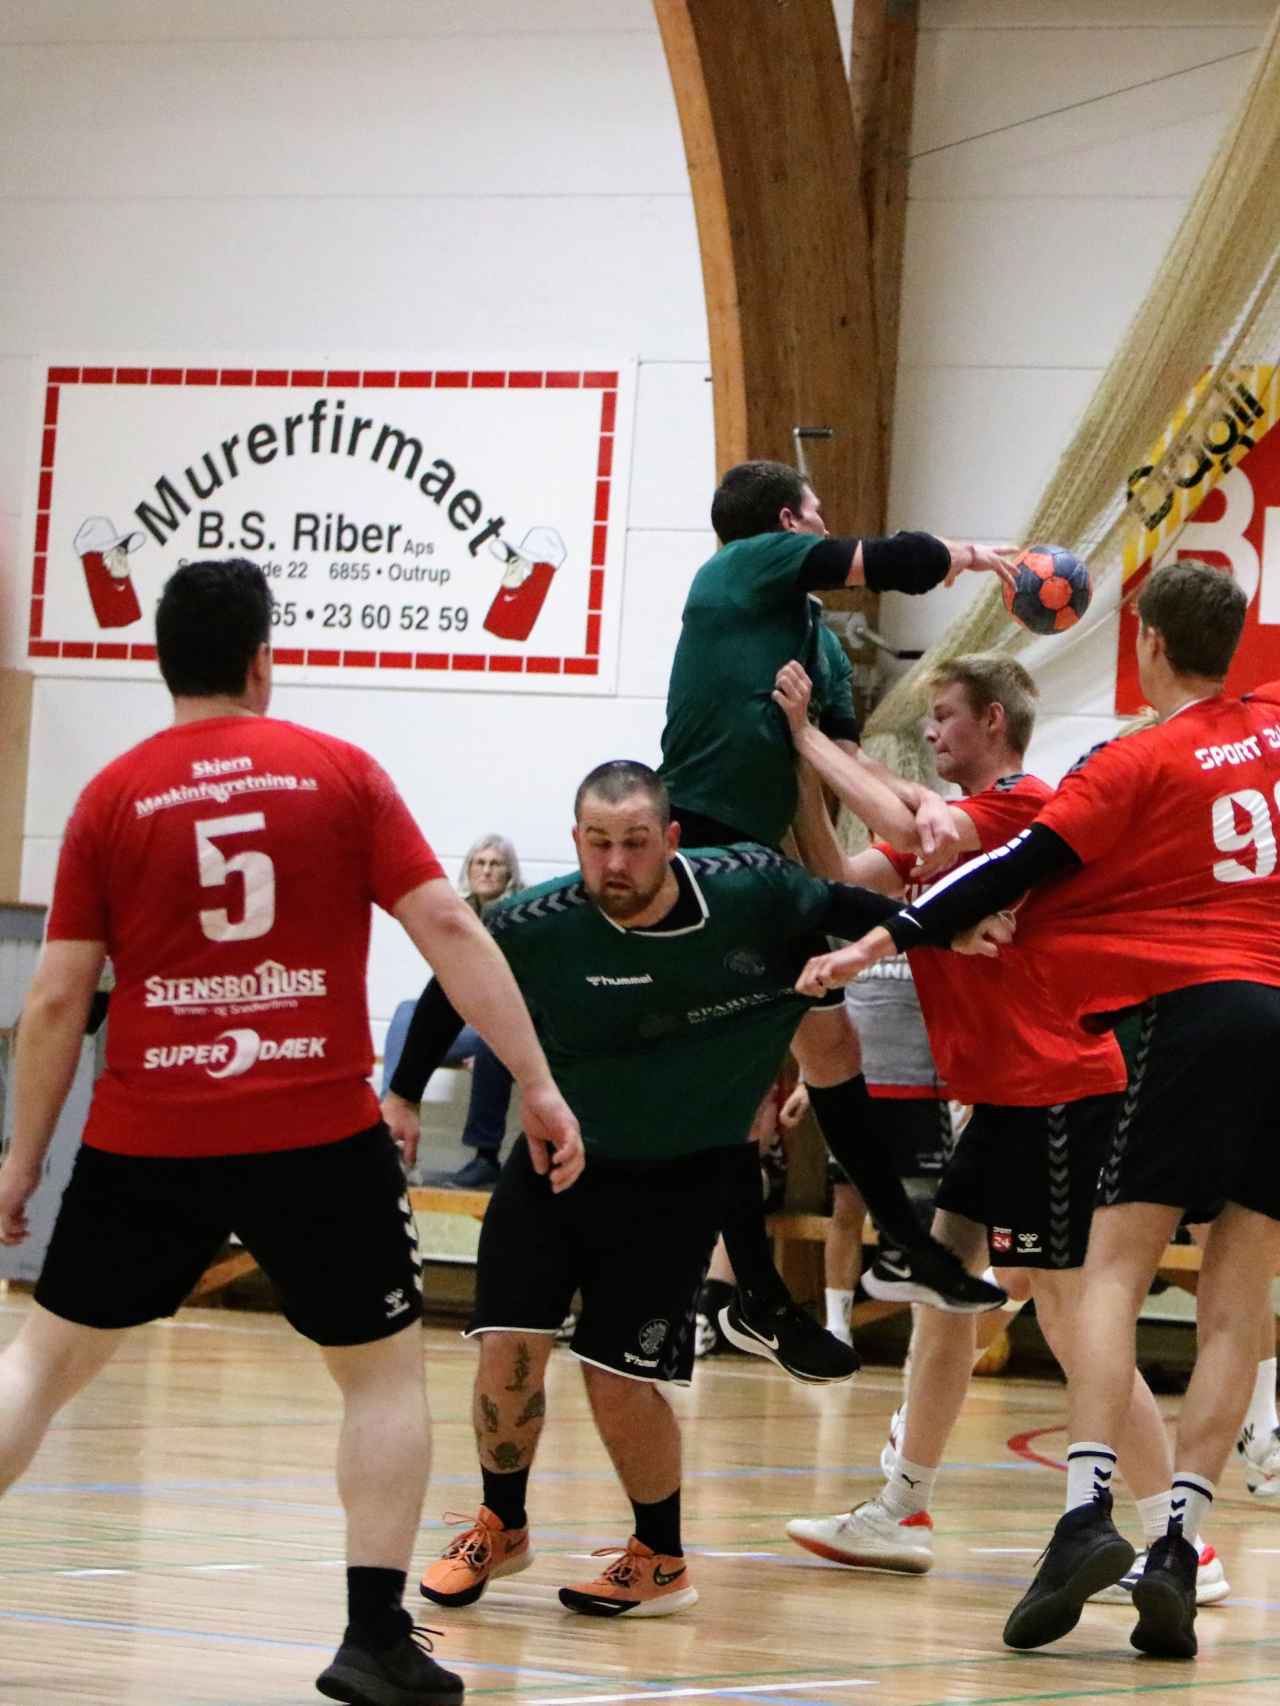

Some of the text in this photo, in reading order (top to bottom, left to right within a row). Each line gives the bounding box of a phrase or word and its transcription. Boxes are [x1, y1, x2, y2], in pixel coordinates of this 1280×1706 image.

[135, 398, 505, 557] Murerfirmaet
[198, 511, 434, 555] B.S. Riber Aps
[287, 561, 308, 579] 22
[328, 563, 371, 580] 6855
[388, 563, 450, 585] Outrup
[322, 603, 352, 628] 23
[361, 604, 391, 630] 60
[399, 605, 429, 631] 52
[438, 606, 469, 632] 59
[192, 755, 253, 778] Skjern
[1194, 735, 1262, 770] SPORT
[194, 811, 276, 942] 5
[144, 960, 328, 1004] STENSBO HUSE
[600, 973, 654, 987] hummel
[143, 1043, 230, 1069] SUPER
